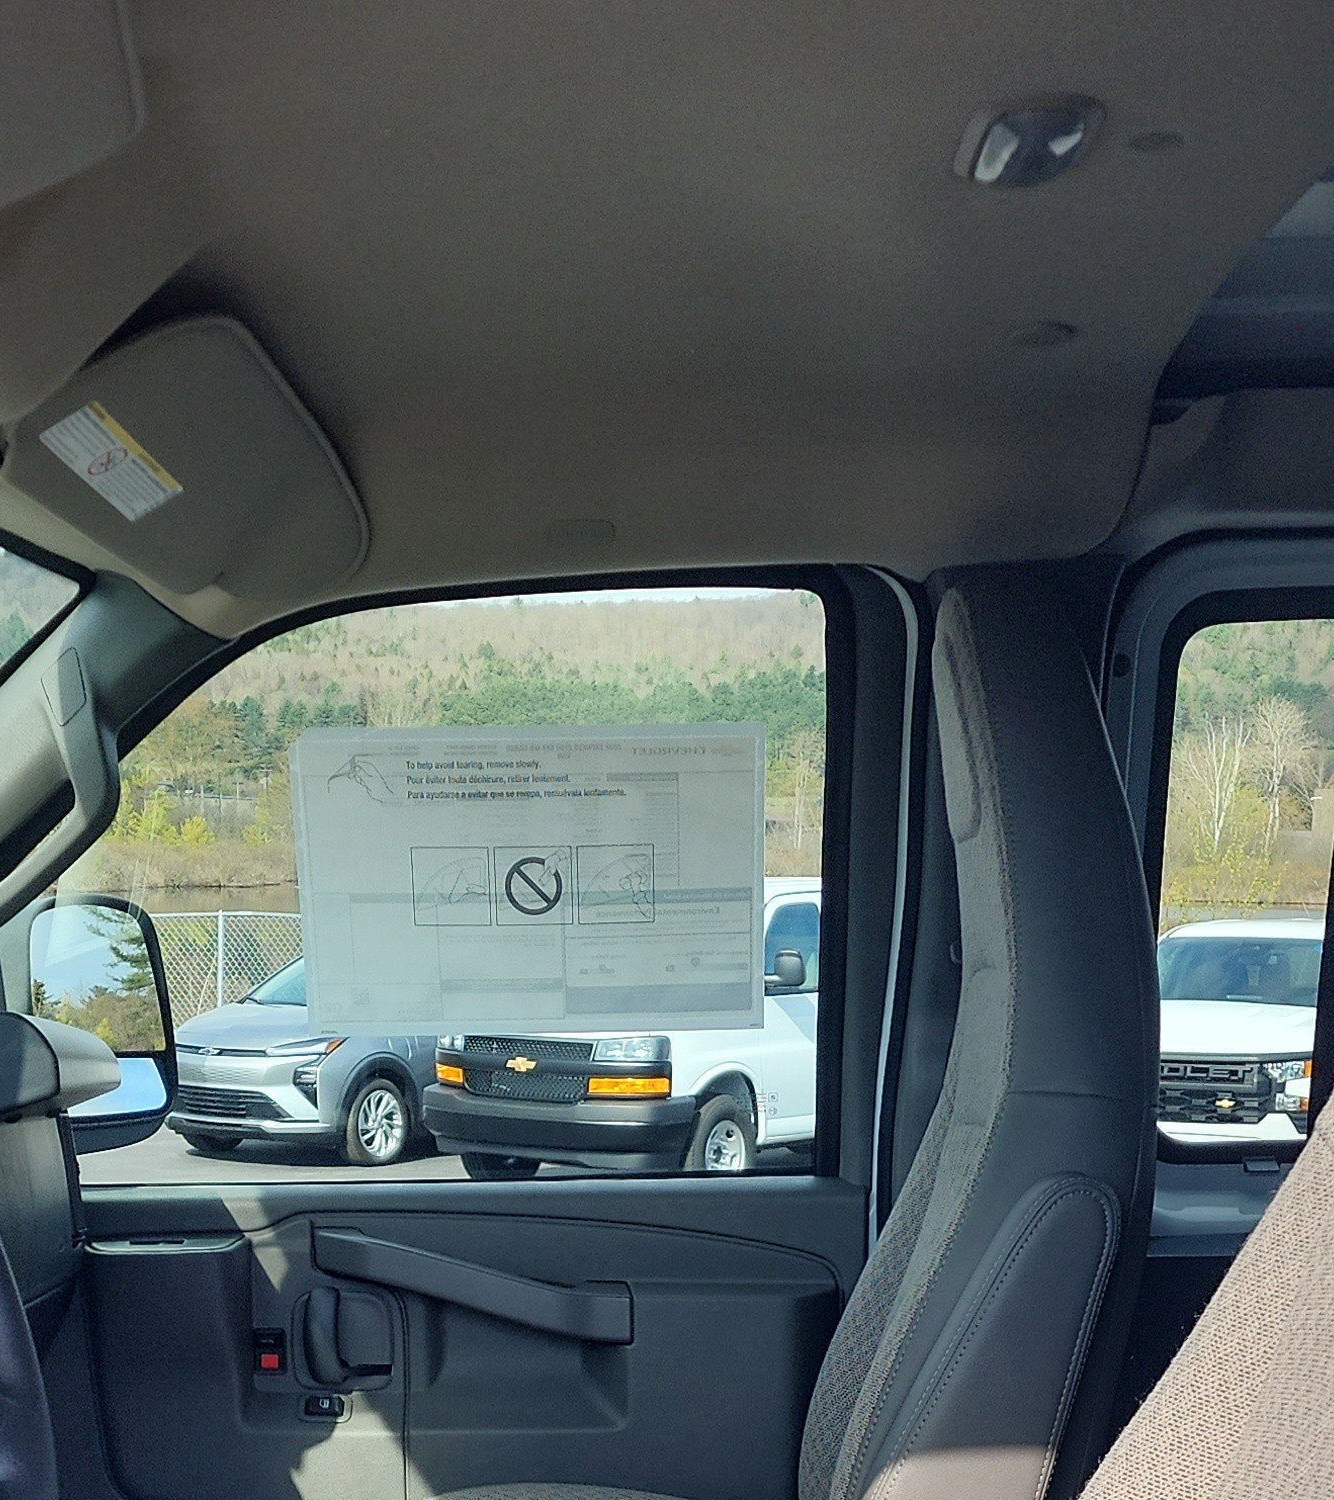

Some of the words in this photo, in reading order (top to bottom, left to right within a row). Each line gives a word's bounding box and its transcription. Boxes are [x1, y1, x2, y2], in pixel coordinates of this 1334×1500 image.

[406, 761, 415, 770] To
[417, 761, 433, 771] help
[434, 761, 455, 770] avoid
[456, 760, 485, 771] tearing,
[487, 761, 514, 769] remove
[515, 760, 542, 770] slowly.
[407, 775, 423, 785] Pour
[425, 775, 446, 784] éviter
[448, 775, 467, 784] toute
[468, 774, 506, 784] déchirure,
[531, 773, 571, 783] lentement.
[407, 790, 424, 799] Para
[426, 790, 460, 800] ayudarse
[468, 789, 488, 799] evitar
[490, 790, 504, 799] que
[505, 790, 515, 798] se
[516, 790, 543, 799] rompa,
[1162, 1064, 1252, 1079] OLET
